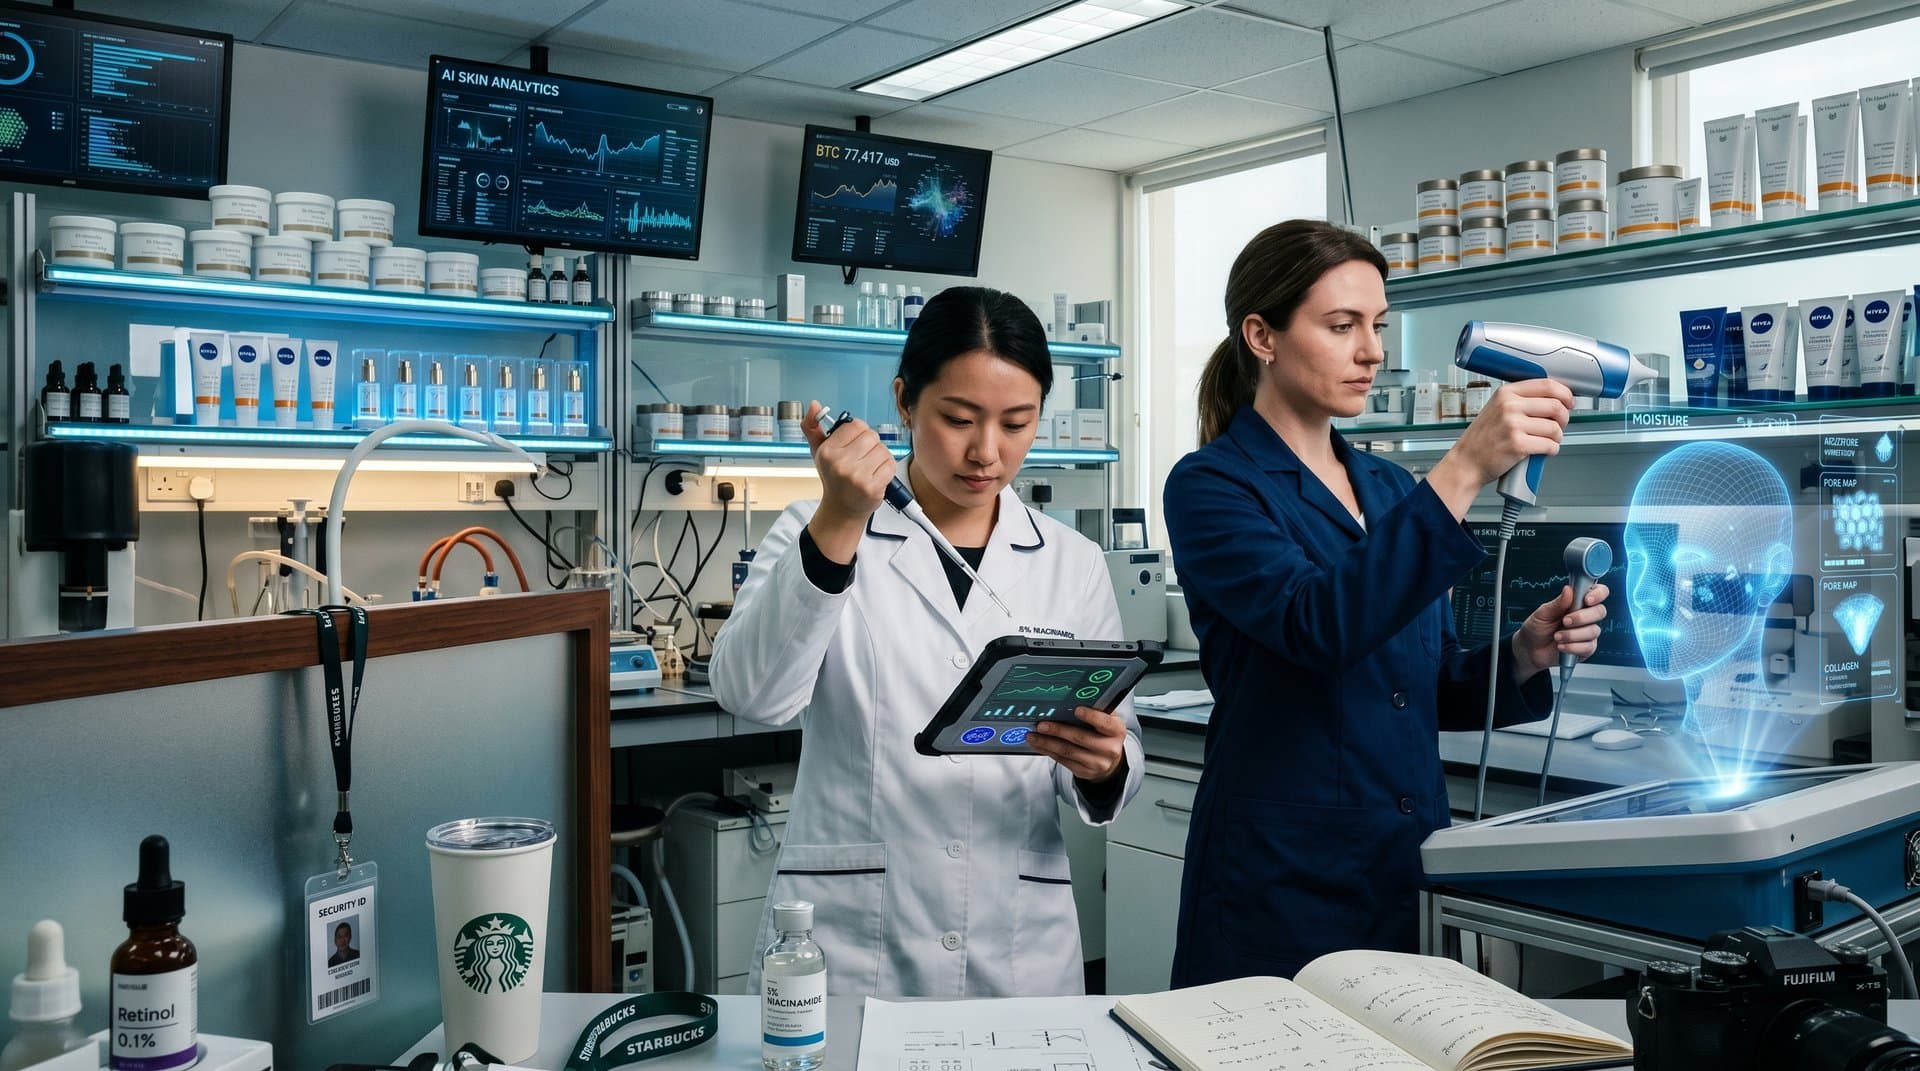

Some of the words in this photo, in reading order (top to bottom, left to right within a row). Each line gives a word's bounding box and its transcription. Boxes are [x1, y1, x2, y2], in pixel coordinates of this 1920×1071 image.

[441, 68, 455, 82] AI
[458, 71, 488, 87] SKIN
[491, 75, 560, 97] ANALYTICS
[815, 144, 840, 159] BTC
[844, 148, 883, 165] 77,417
[884, 157, 900, 167] USD
[1632, 413, 1689, 427] MOISTURE
[1823, 479, 1841, 488] PORE
[1842, 479, 1858, 488] MAP
[1481, 528, 1498, 537] SKIN
[1823, 582, 1841, 591] PORE
[1842, 581, 1858, 590] MAP
[1824, 661, 1860, 673] COLLAGEN
[318, 899, 356, 918] SECURITY
[357, 897, 367, 907] ID
[1783, 971, 1836, 986] FUJIFILM
[767, 986, 779, 997] 5%
[767, 994, 823, 1008] NIACINAMIDE
[118, 1004, 175, 1023] Retinol
[118, 1032, 156, 1049] 0.1%
[626, 1025, 705, 1056] STARBUCKS
